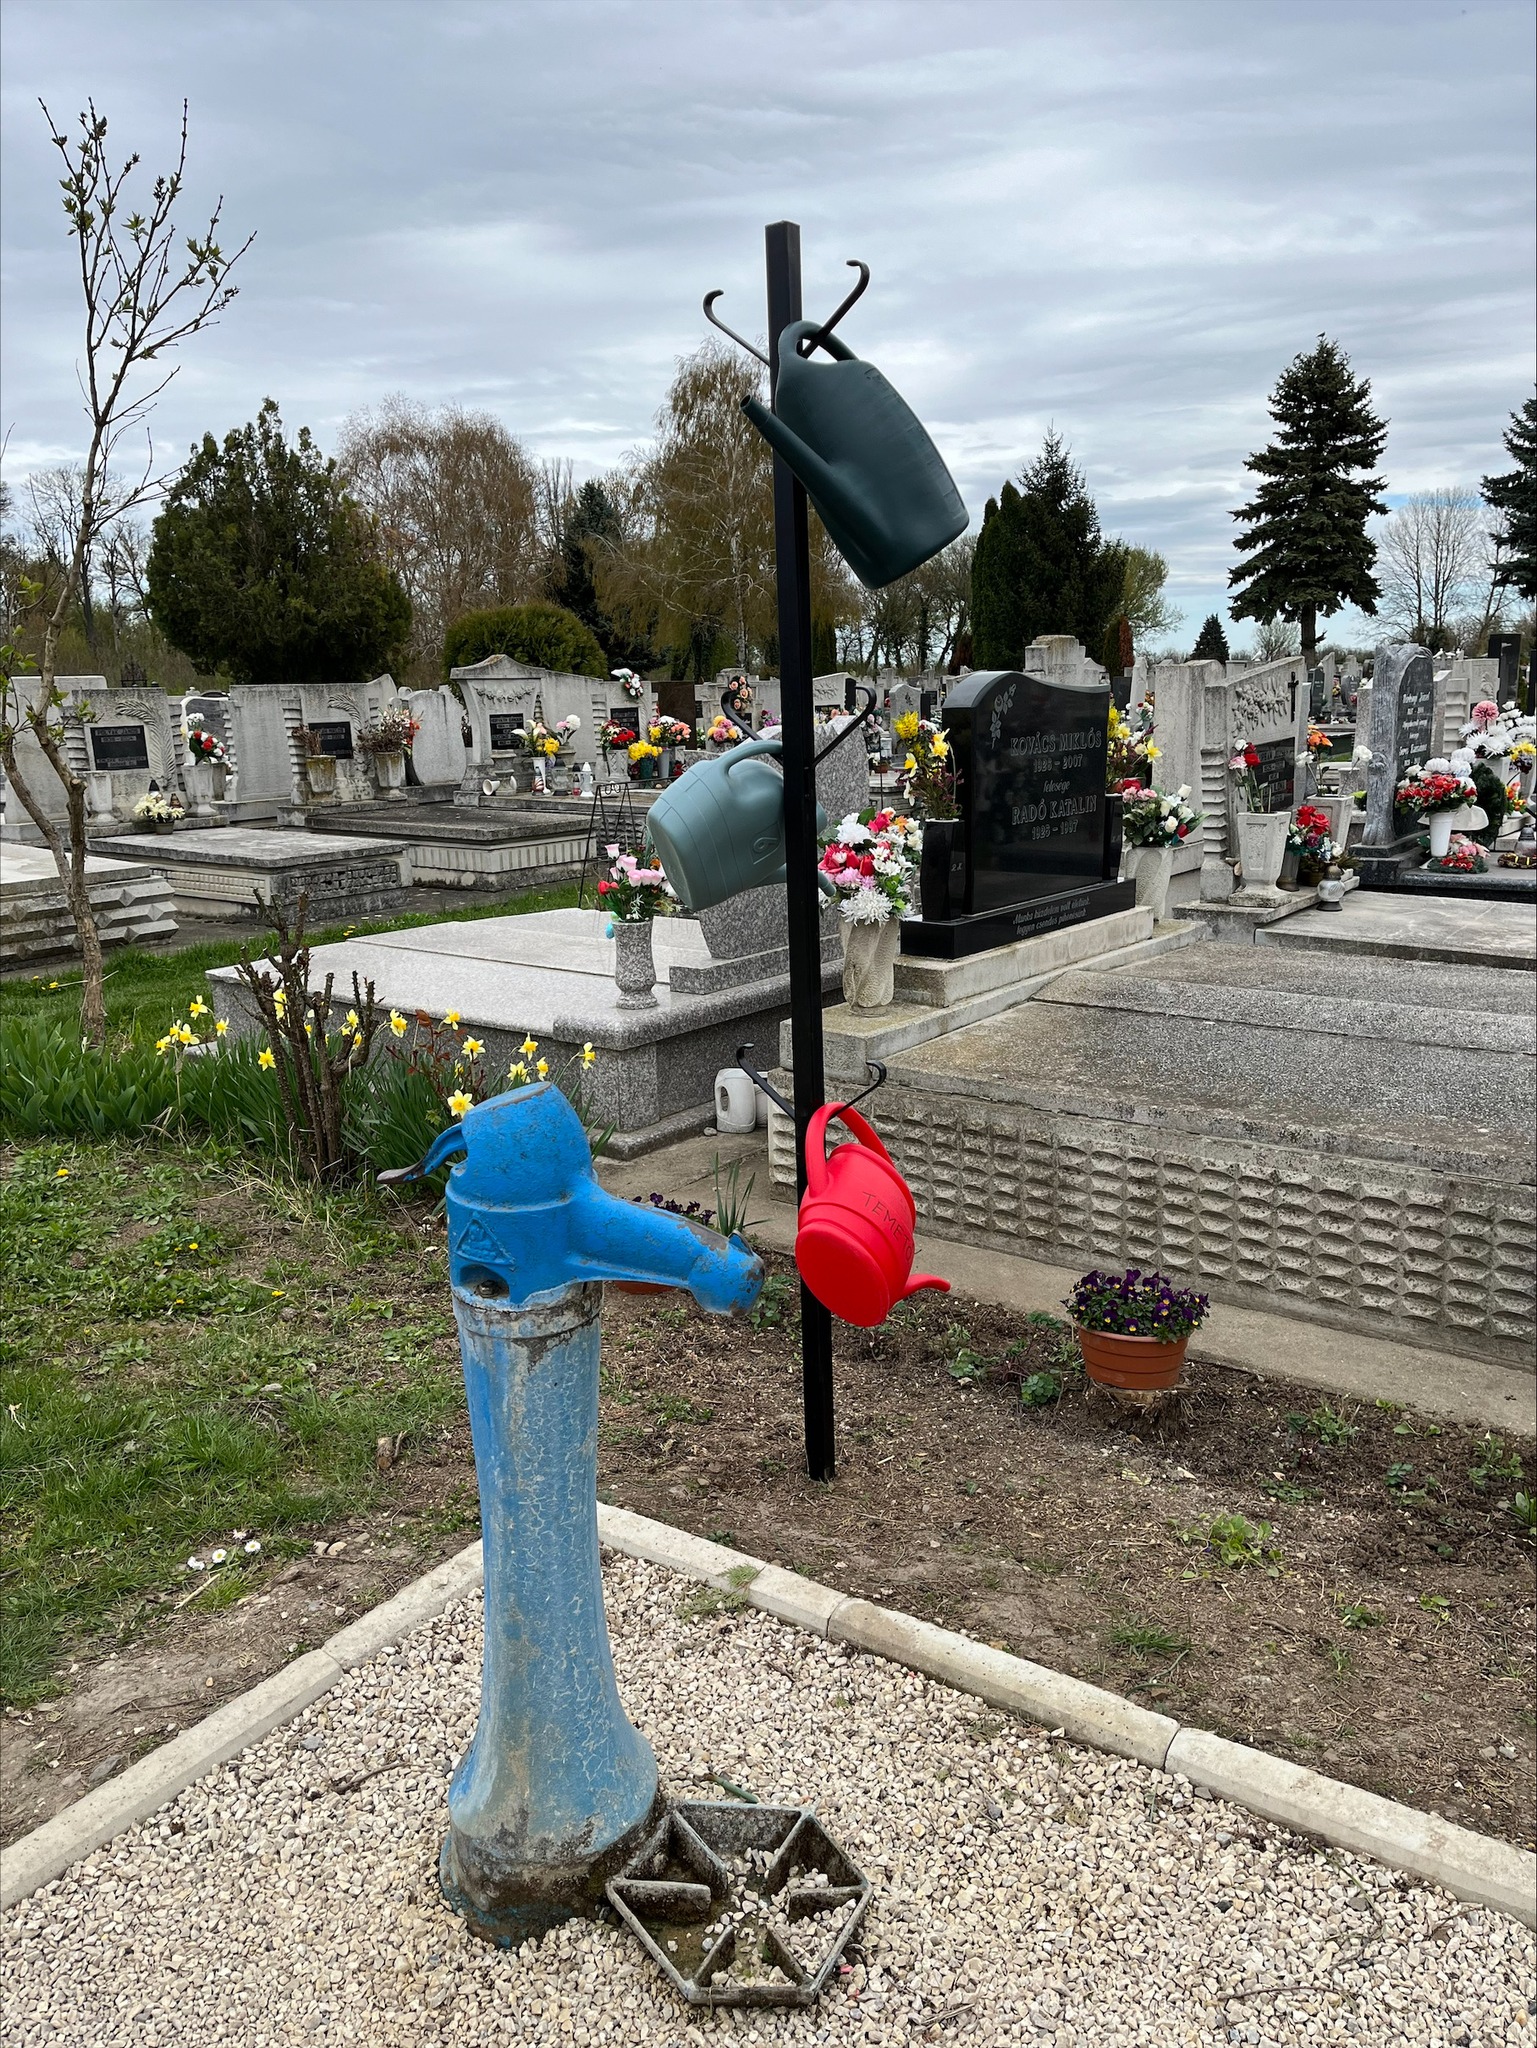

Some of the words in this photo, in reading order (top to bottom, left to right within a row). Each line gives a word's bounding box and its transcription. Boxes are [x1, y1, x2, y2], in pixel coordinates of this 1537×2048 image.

[1010, 731, 1056, 756] KOVÁCS
[1058, 727, 1102, 751] MIKLÓS
[1062, 753, 1083, 770] 2007
[1043, 779, 1071, 794] felesége
[1011, 798, 1047, 825] RADÓ
[1049, 794, 1097, 819] KATALIN
